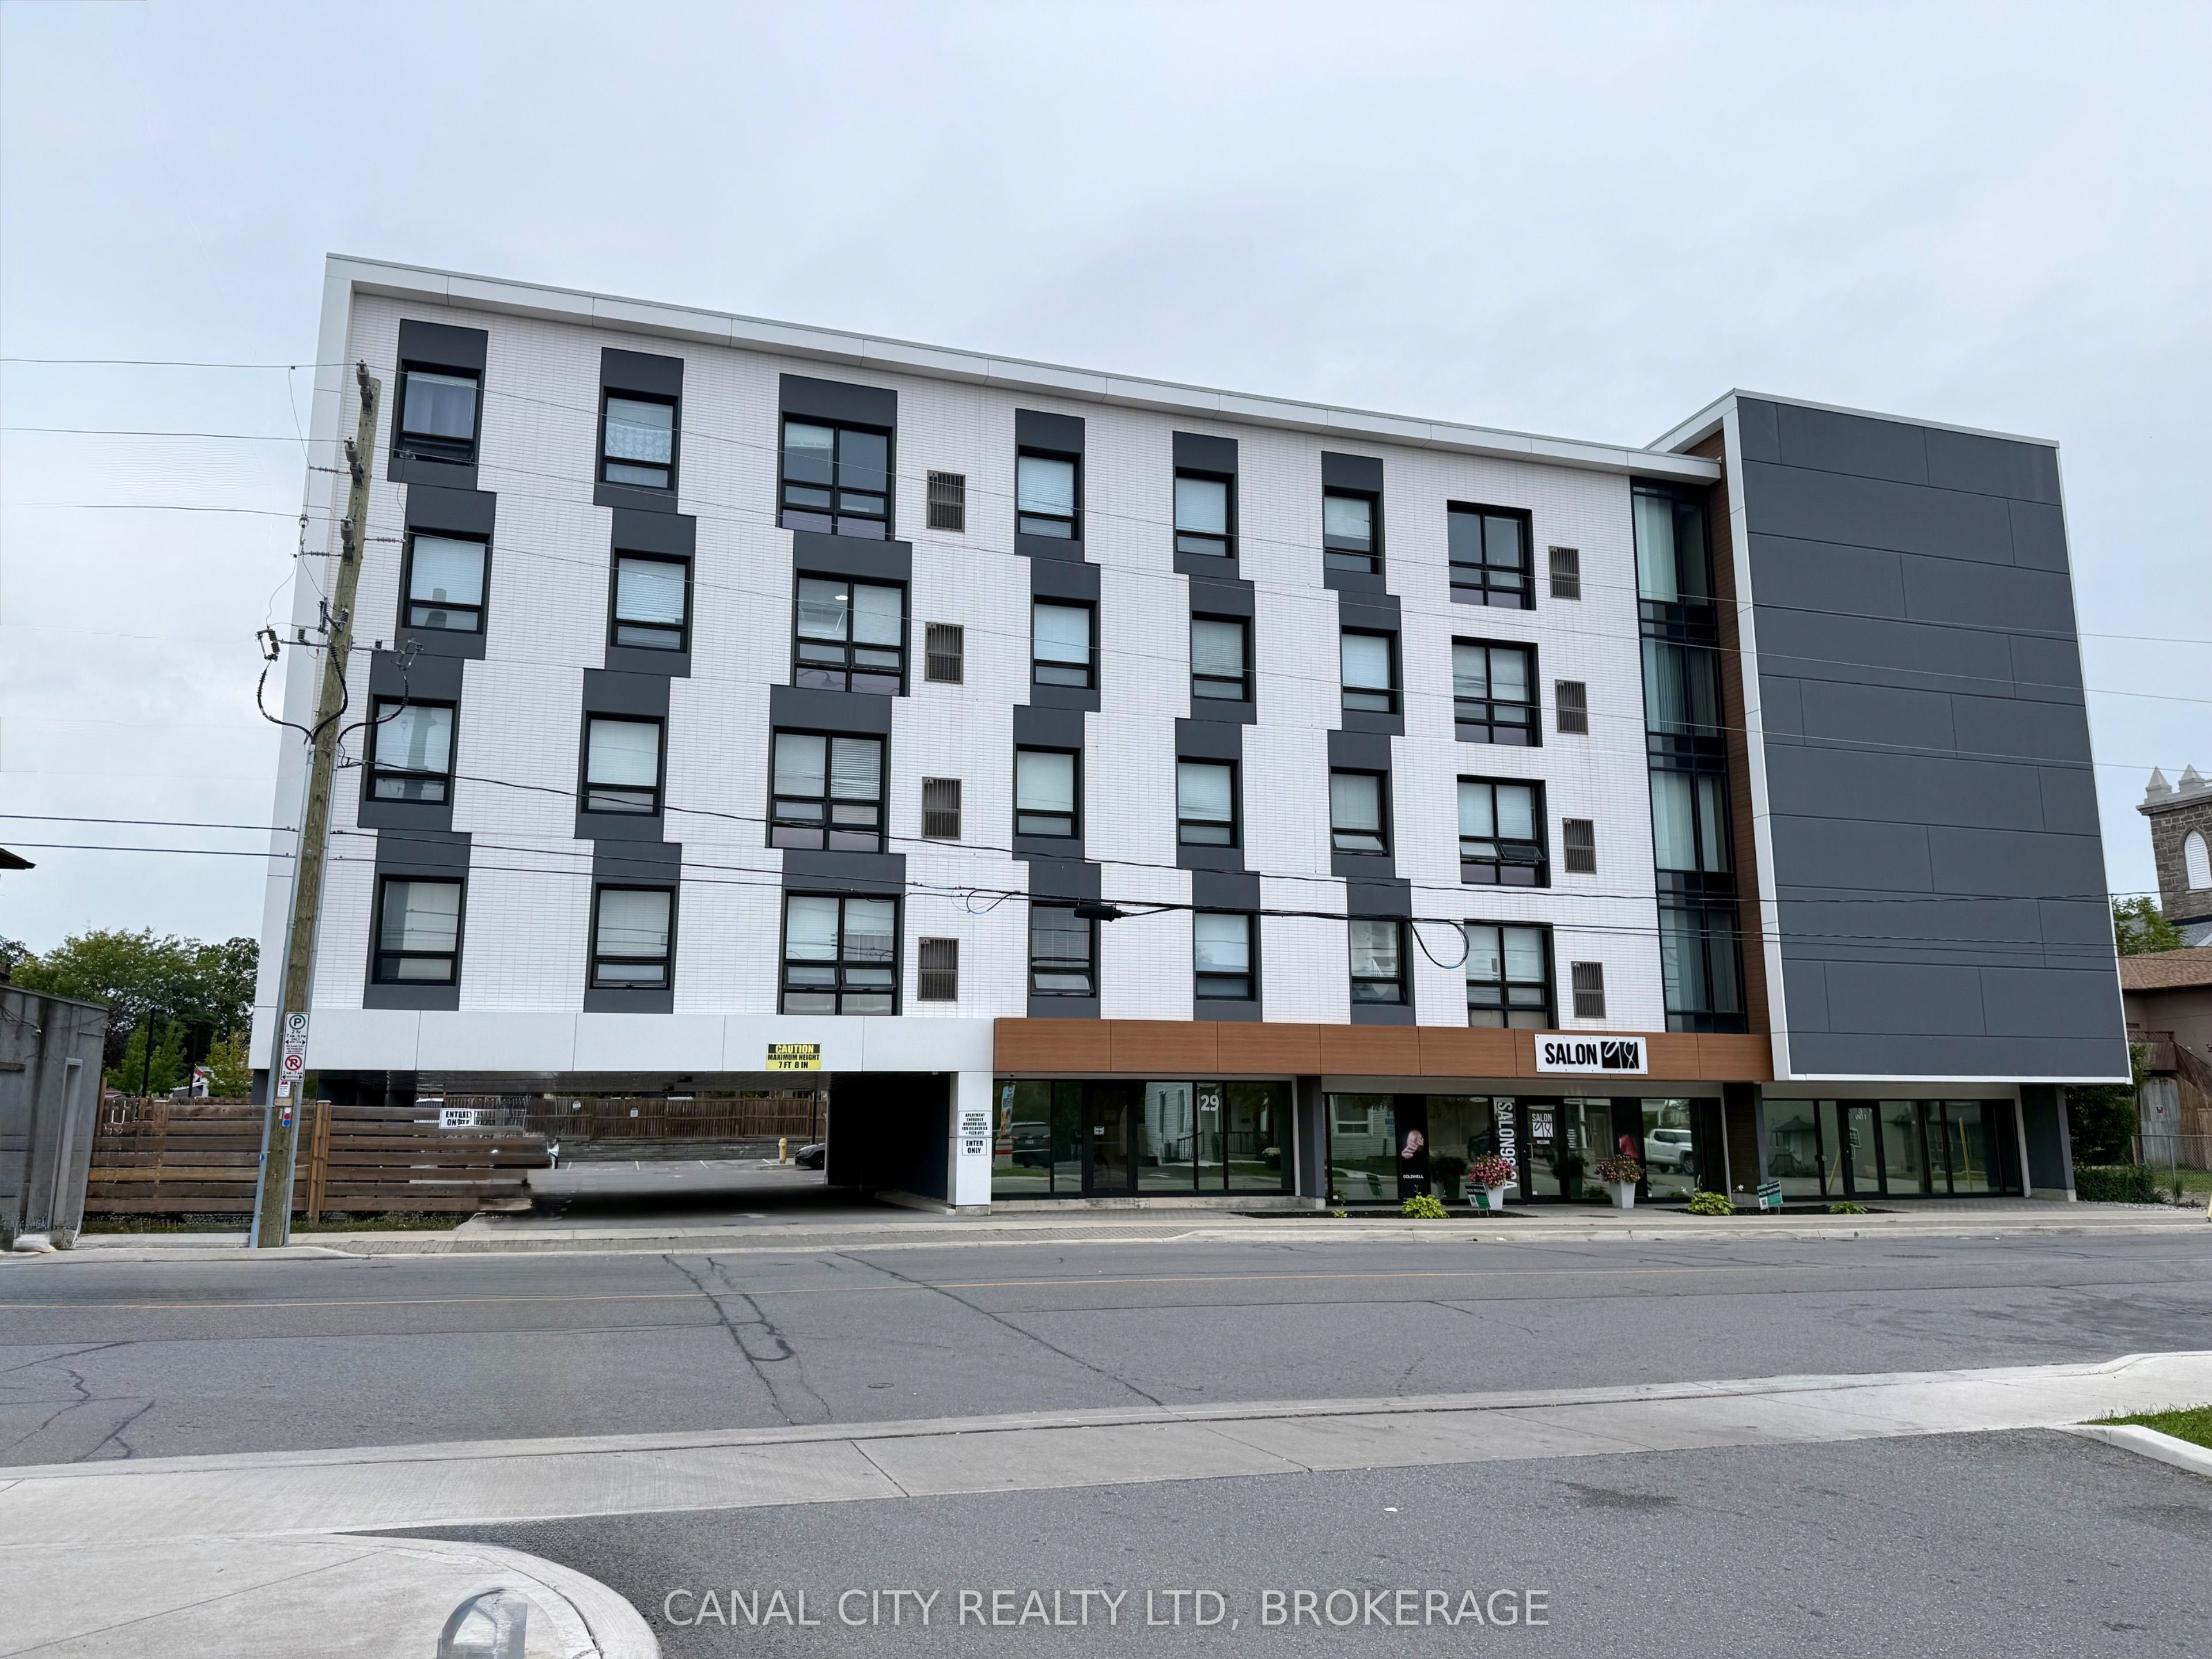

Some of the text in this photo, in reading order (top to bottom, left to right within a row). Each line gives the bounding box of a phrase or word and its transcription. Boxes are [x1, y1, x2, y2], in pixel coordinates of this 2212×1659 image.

[294, 1018, 302, 1027] P
[775, 1044, 814, 1053] CAUTION
[1545, 1041, 1639, 1069] SALON 98
[1200, 1094, 1219, 1111] 29
[1532, 1113, 1552, 1122] SALON
